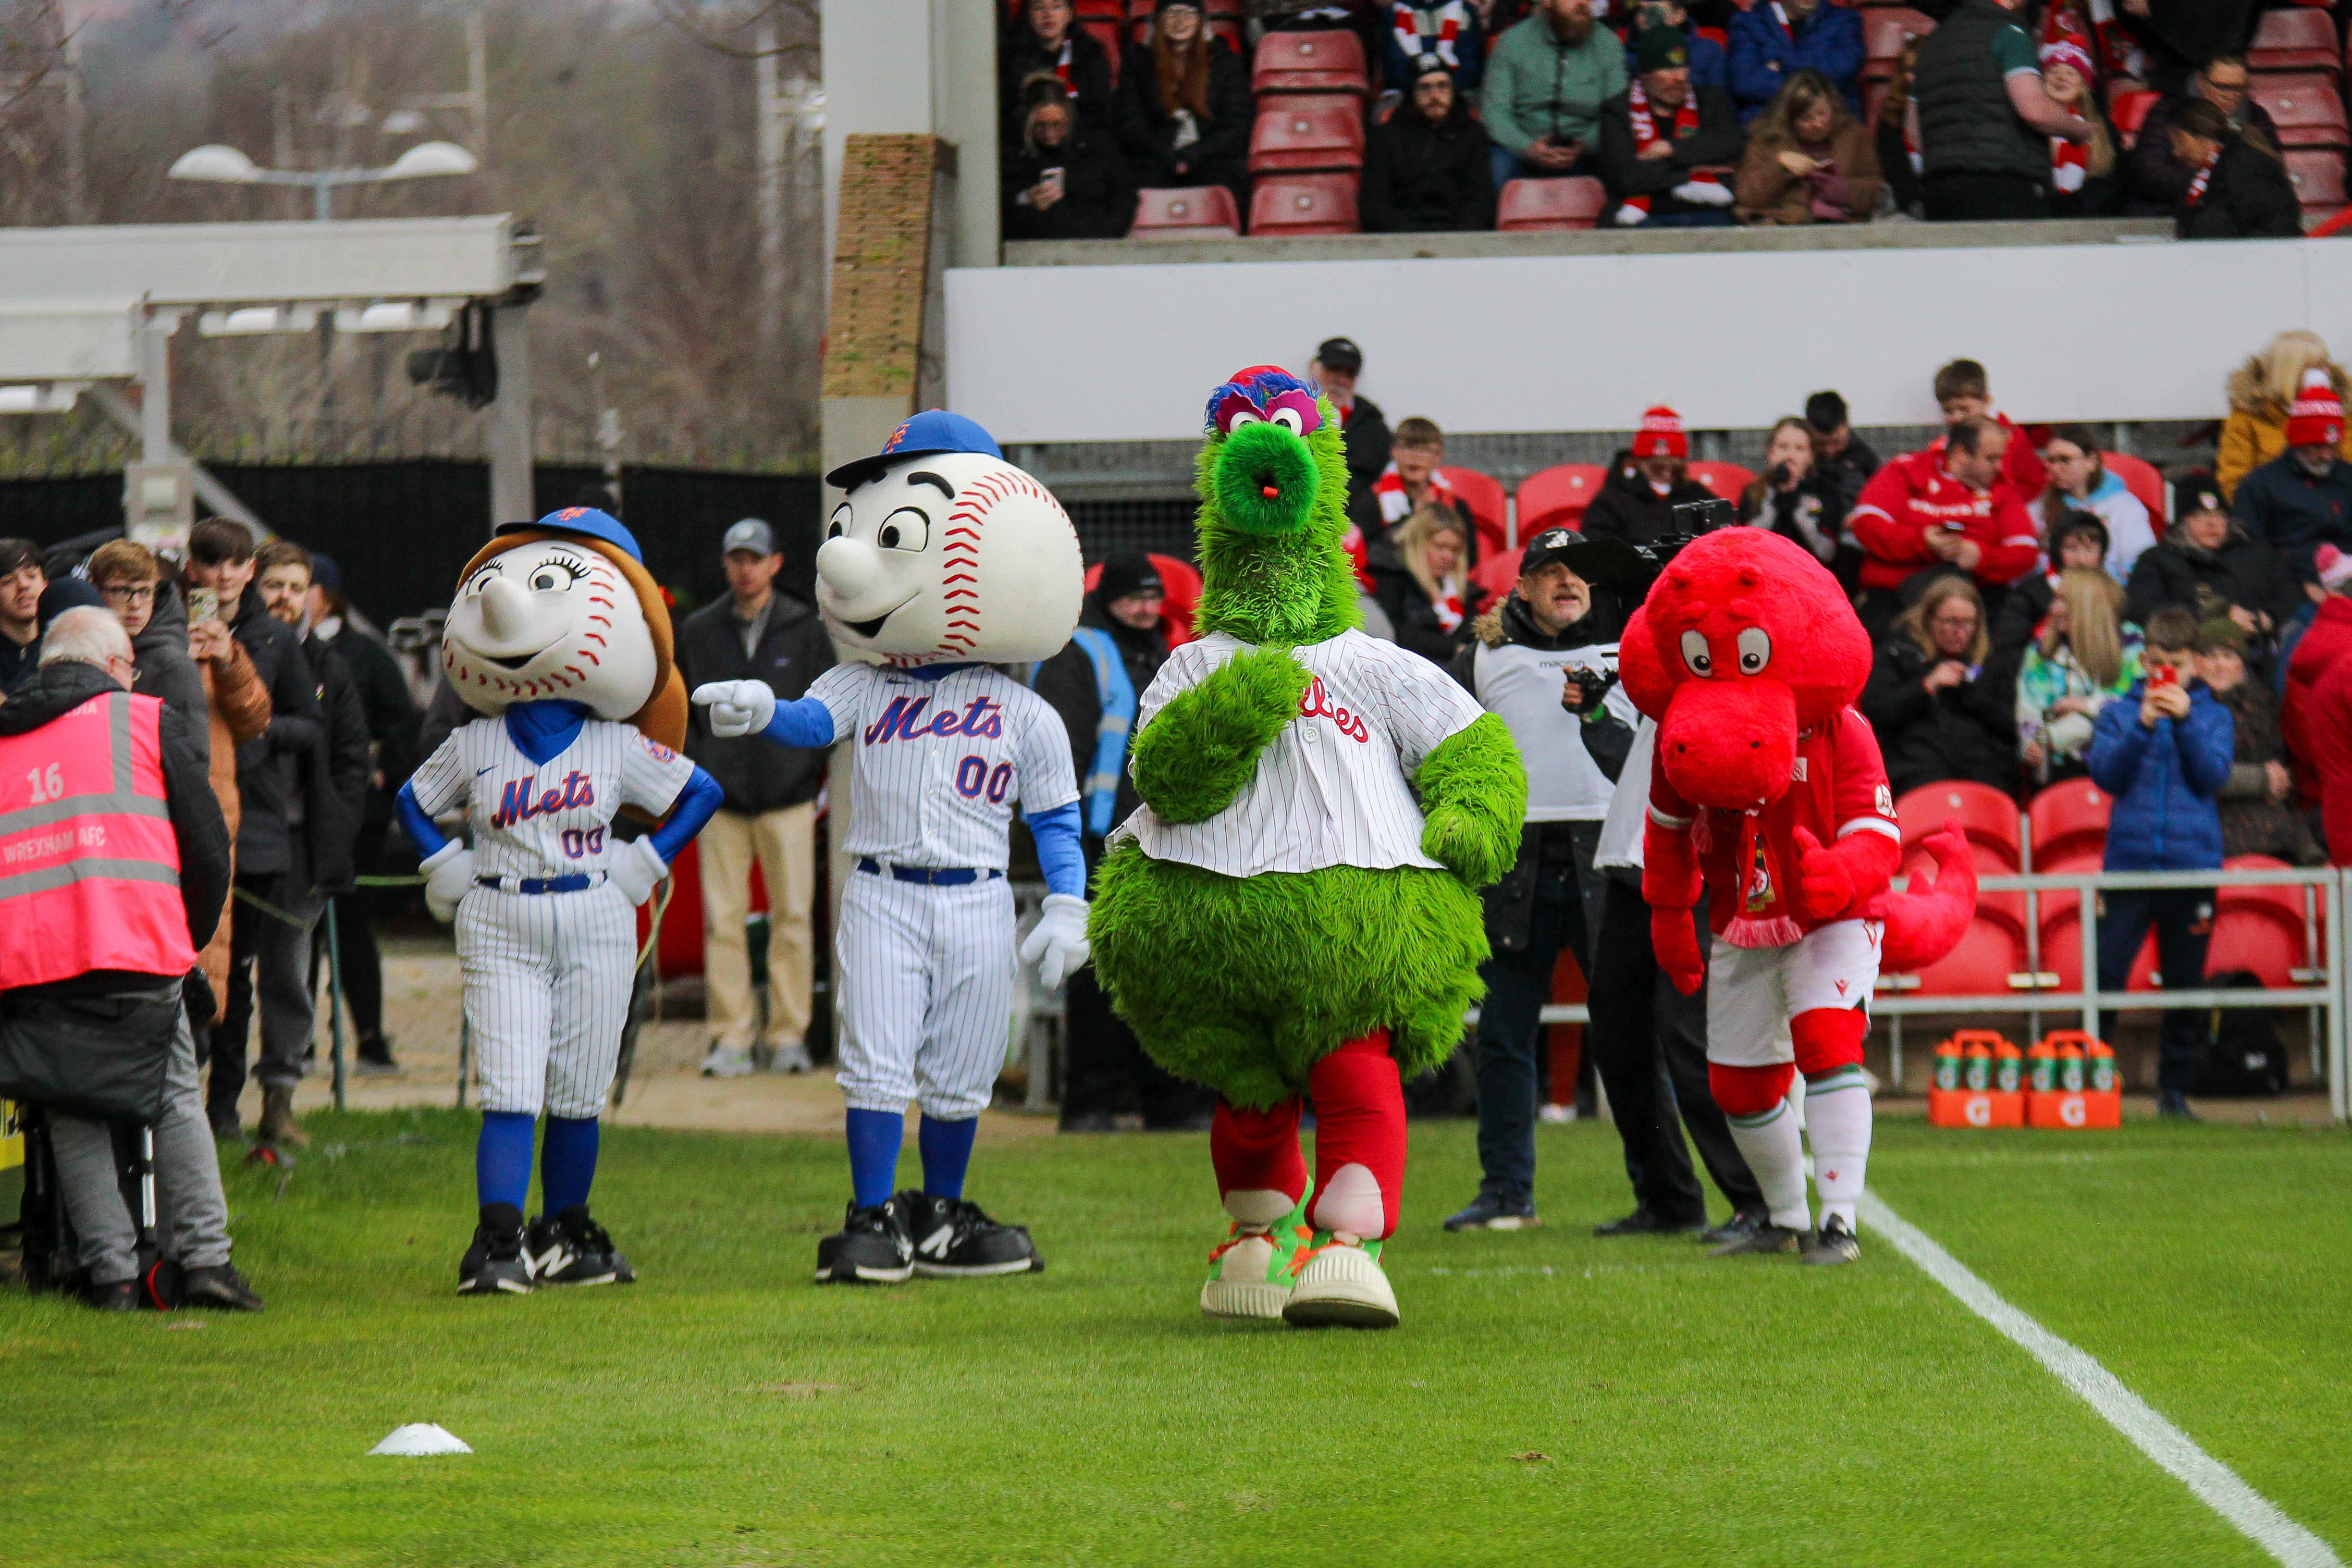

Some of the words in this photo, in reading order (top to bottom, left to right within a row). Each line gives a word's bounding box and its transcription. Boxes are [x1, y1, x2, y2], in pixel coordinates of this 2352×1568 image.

[865, 696, 1002, 746] Mets
[27, 761, 64, 804] 16
[955, 755, 1012, 803] 00
[490, 770, 594, 830] Mets
[3, 830, 75, 864] WREXHAM
[79, 826, 105, 847] AFC
[561, 829, 605, 859] 00
[1965, 1096, 1991, 1127] G
[2060, 1096, 2085, 1128] G
